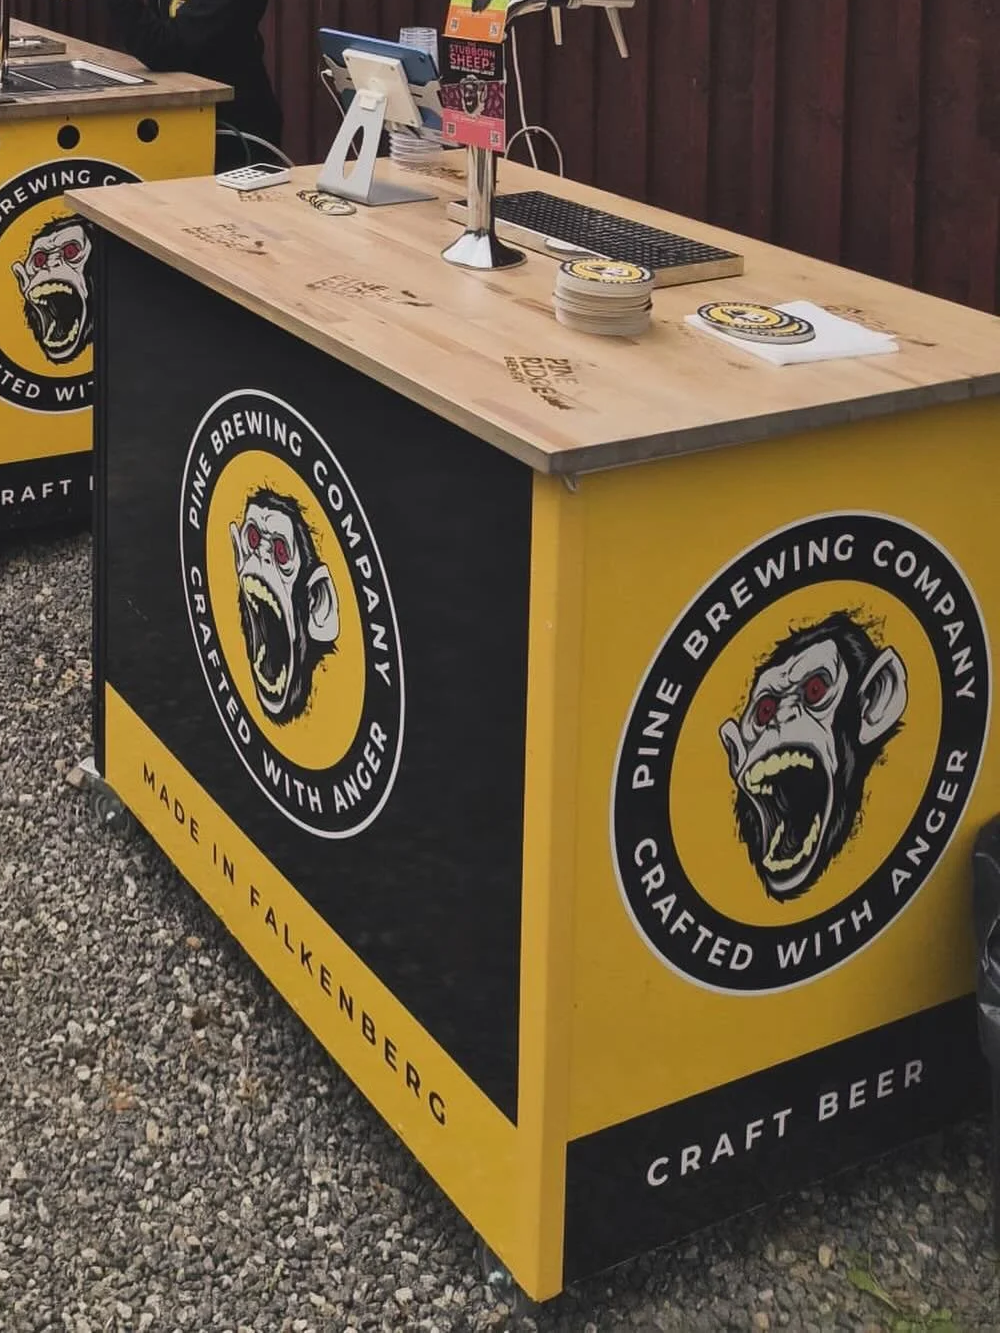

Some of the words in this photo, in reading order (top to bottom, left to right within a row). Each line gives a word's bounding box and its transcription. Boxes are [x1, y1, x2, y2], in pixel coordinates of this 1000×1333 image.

[450, 44, 495, 58] STUBBORN
[55, 379, 94, 403] WI
[189, 453, 212, 530] PINE
[210, 410, 302, 457] BREWING
[313, 460, 391, 686] COMPANY
[632, 677, 683, 790] PINE
[683, 533, 855, 661] BREWING
[873, 539, 976, 701] COMPANY
[190, 566, 251, 745] CRAFTED
[262, 748, 324, 814] WITH
[333, 721, 388, 814] ANGER
[143, 762, 200, 844] MADE
[213, 842, 236, 886] IN
[249, 884, 448, 1126] FALKENBERG
[633, 838, 753, 971] CRAFTED
[776, 899, 874, 969] WITH
[889, 749, 969, 896] ANGER
[646, 1108, 793, 1187] CRAFT
[818, 1059, 924, 1122] BEER
